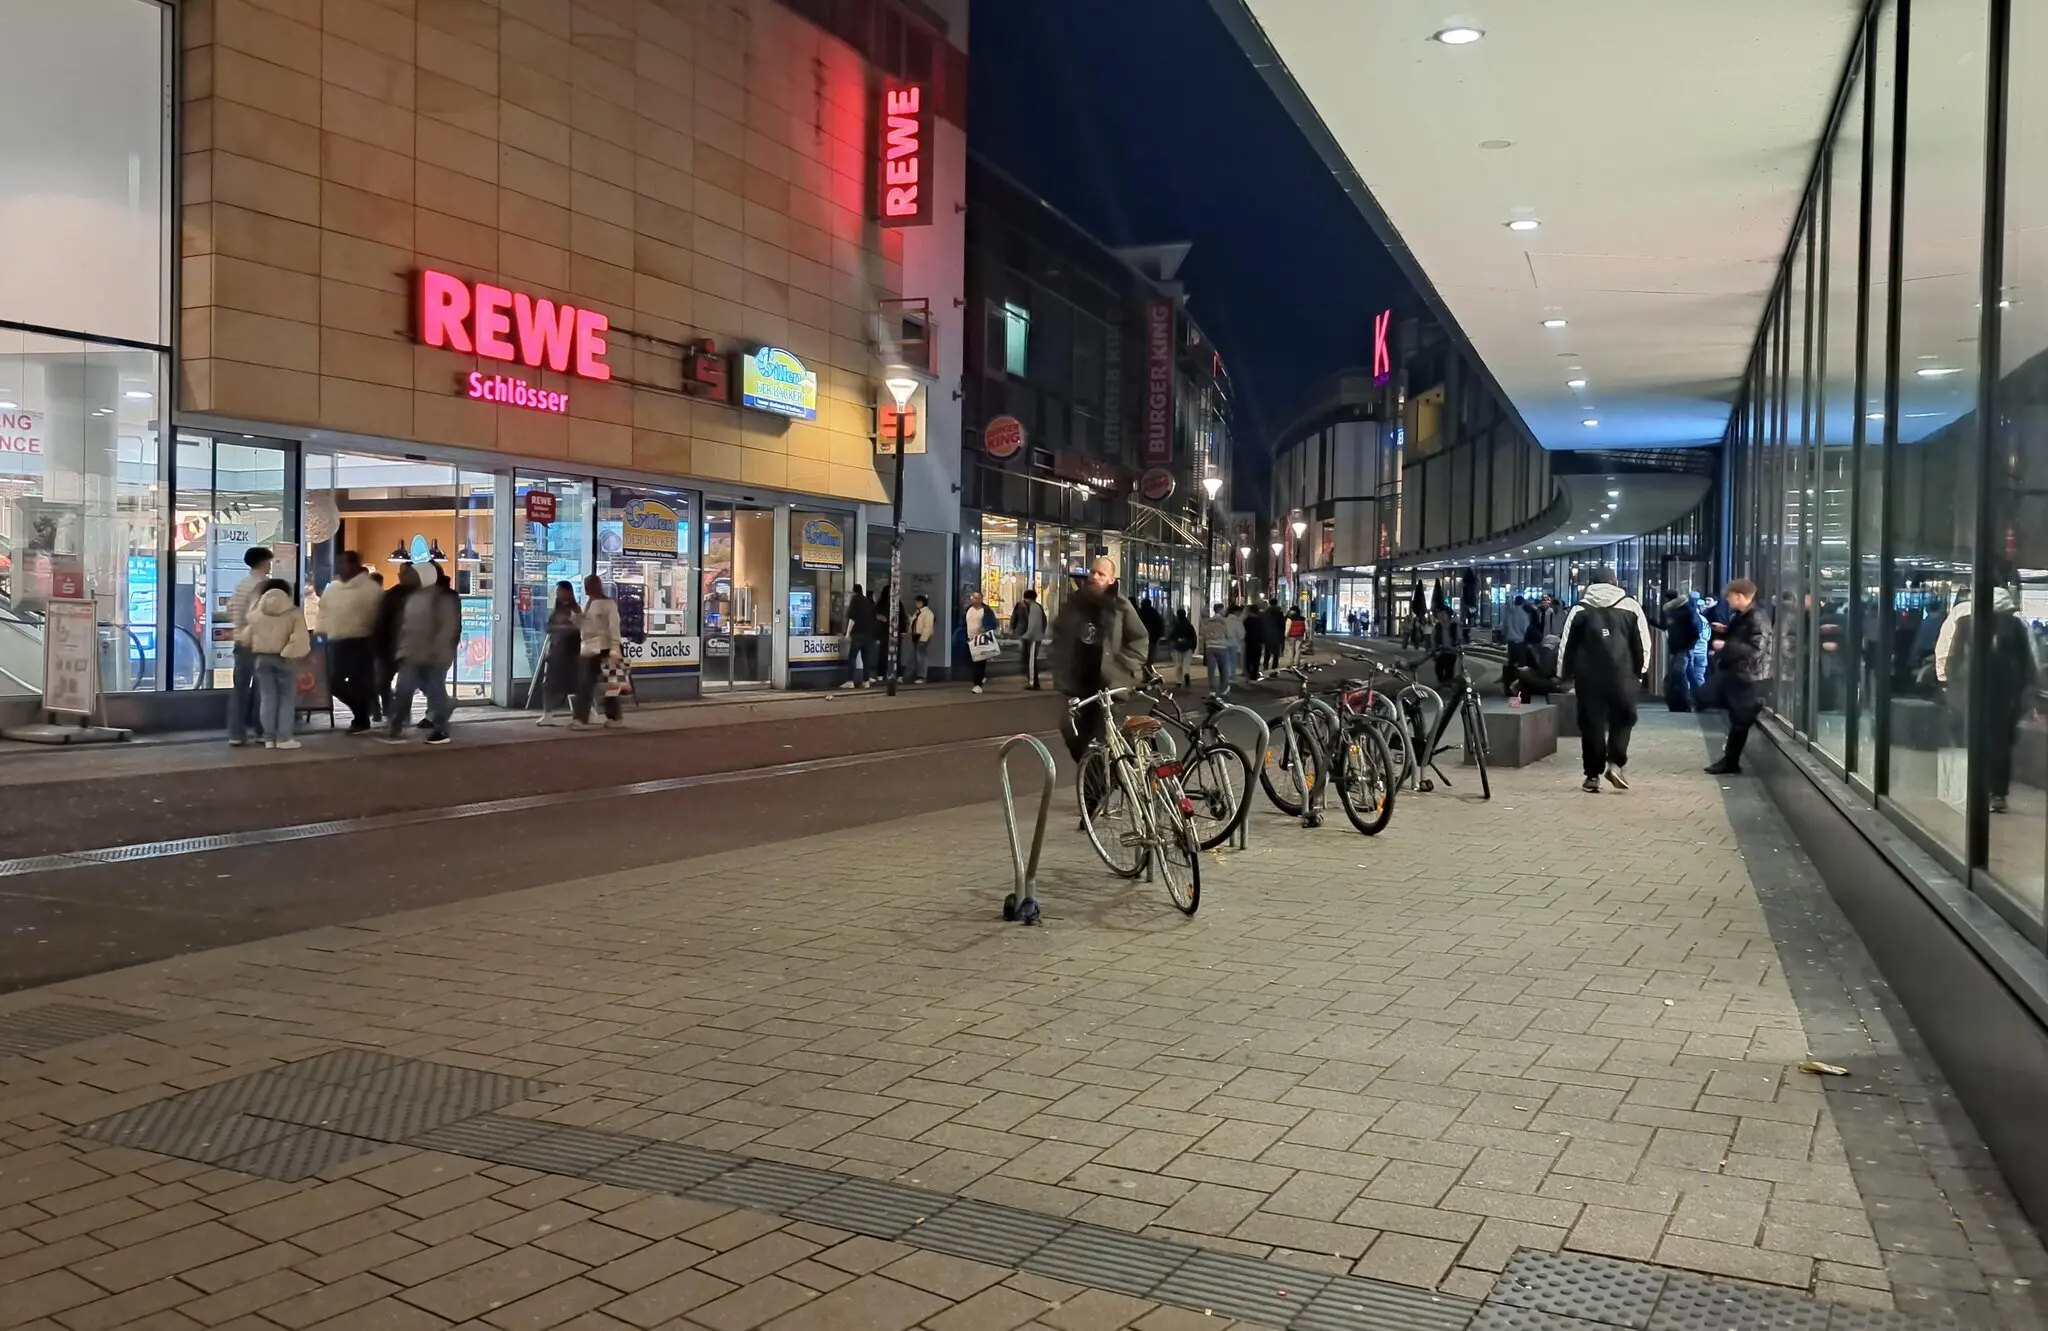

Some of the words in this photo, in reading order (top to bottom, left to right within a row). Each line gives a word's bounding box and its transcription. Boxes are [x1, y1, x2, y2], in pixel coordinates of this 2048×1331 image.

[887, 87, 919, 216] REWE
[424, 270, 611, 380] REWE
[1152, 306, 1168, 360] KING
[469, 372, 568, 412] Schlösser
[1149, 366, 1167, 452] BURGER
[0, 414, 31, 430] NG
[531, 495, 552, 505] REWE
[626, 500, 676, 531] Gillen
[622, 642, 643, 657] ffee
[651, 640, 691, 657] Snacks
